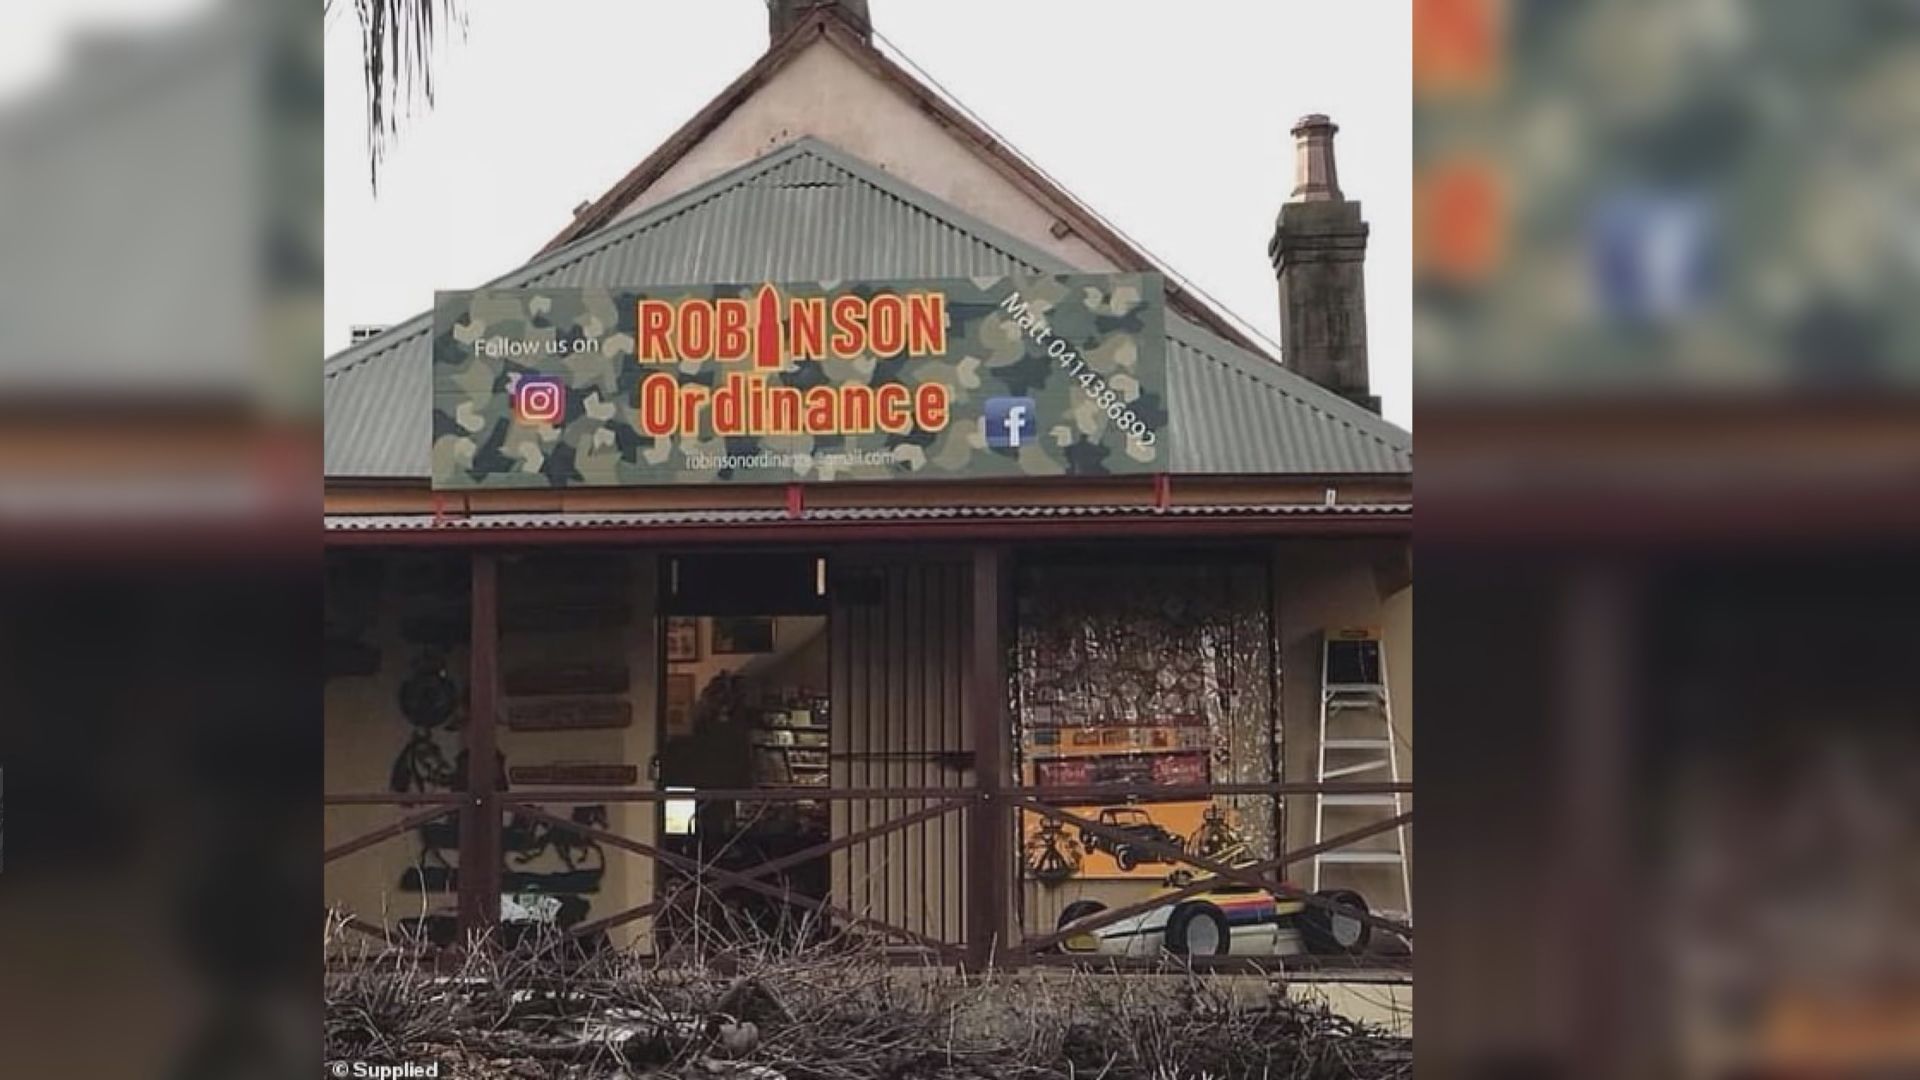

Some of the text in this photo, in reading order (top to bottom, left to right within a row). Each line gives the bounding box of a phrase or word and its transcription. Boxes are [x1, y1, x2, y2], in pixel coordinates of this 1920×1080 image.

[474, 336, 599, 357] Follow us on
[637, 283, 948, 371] ROBINSON
[641, 371, 949, 437] Ordinance
[1001, 291, 1156, 446] Matt 0414386892
